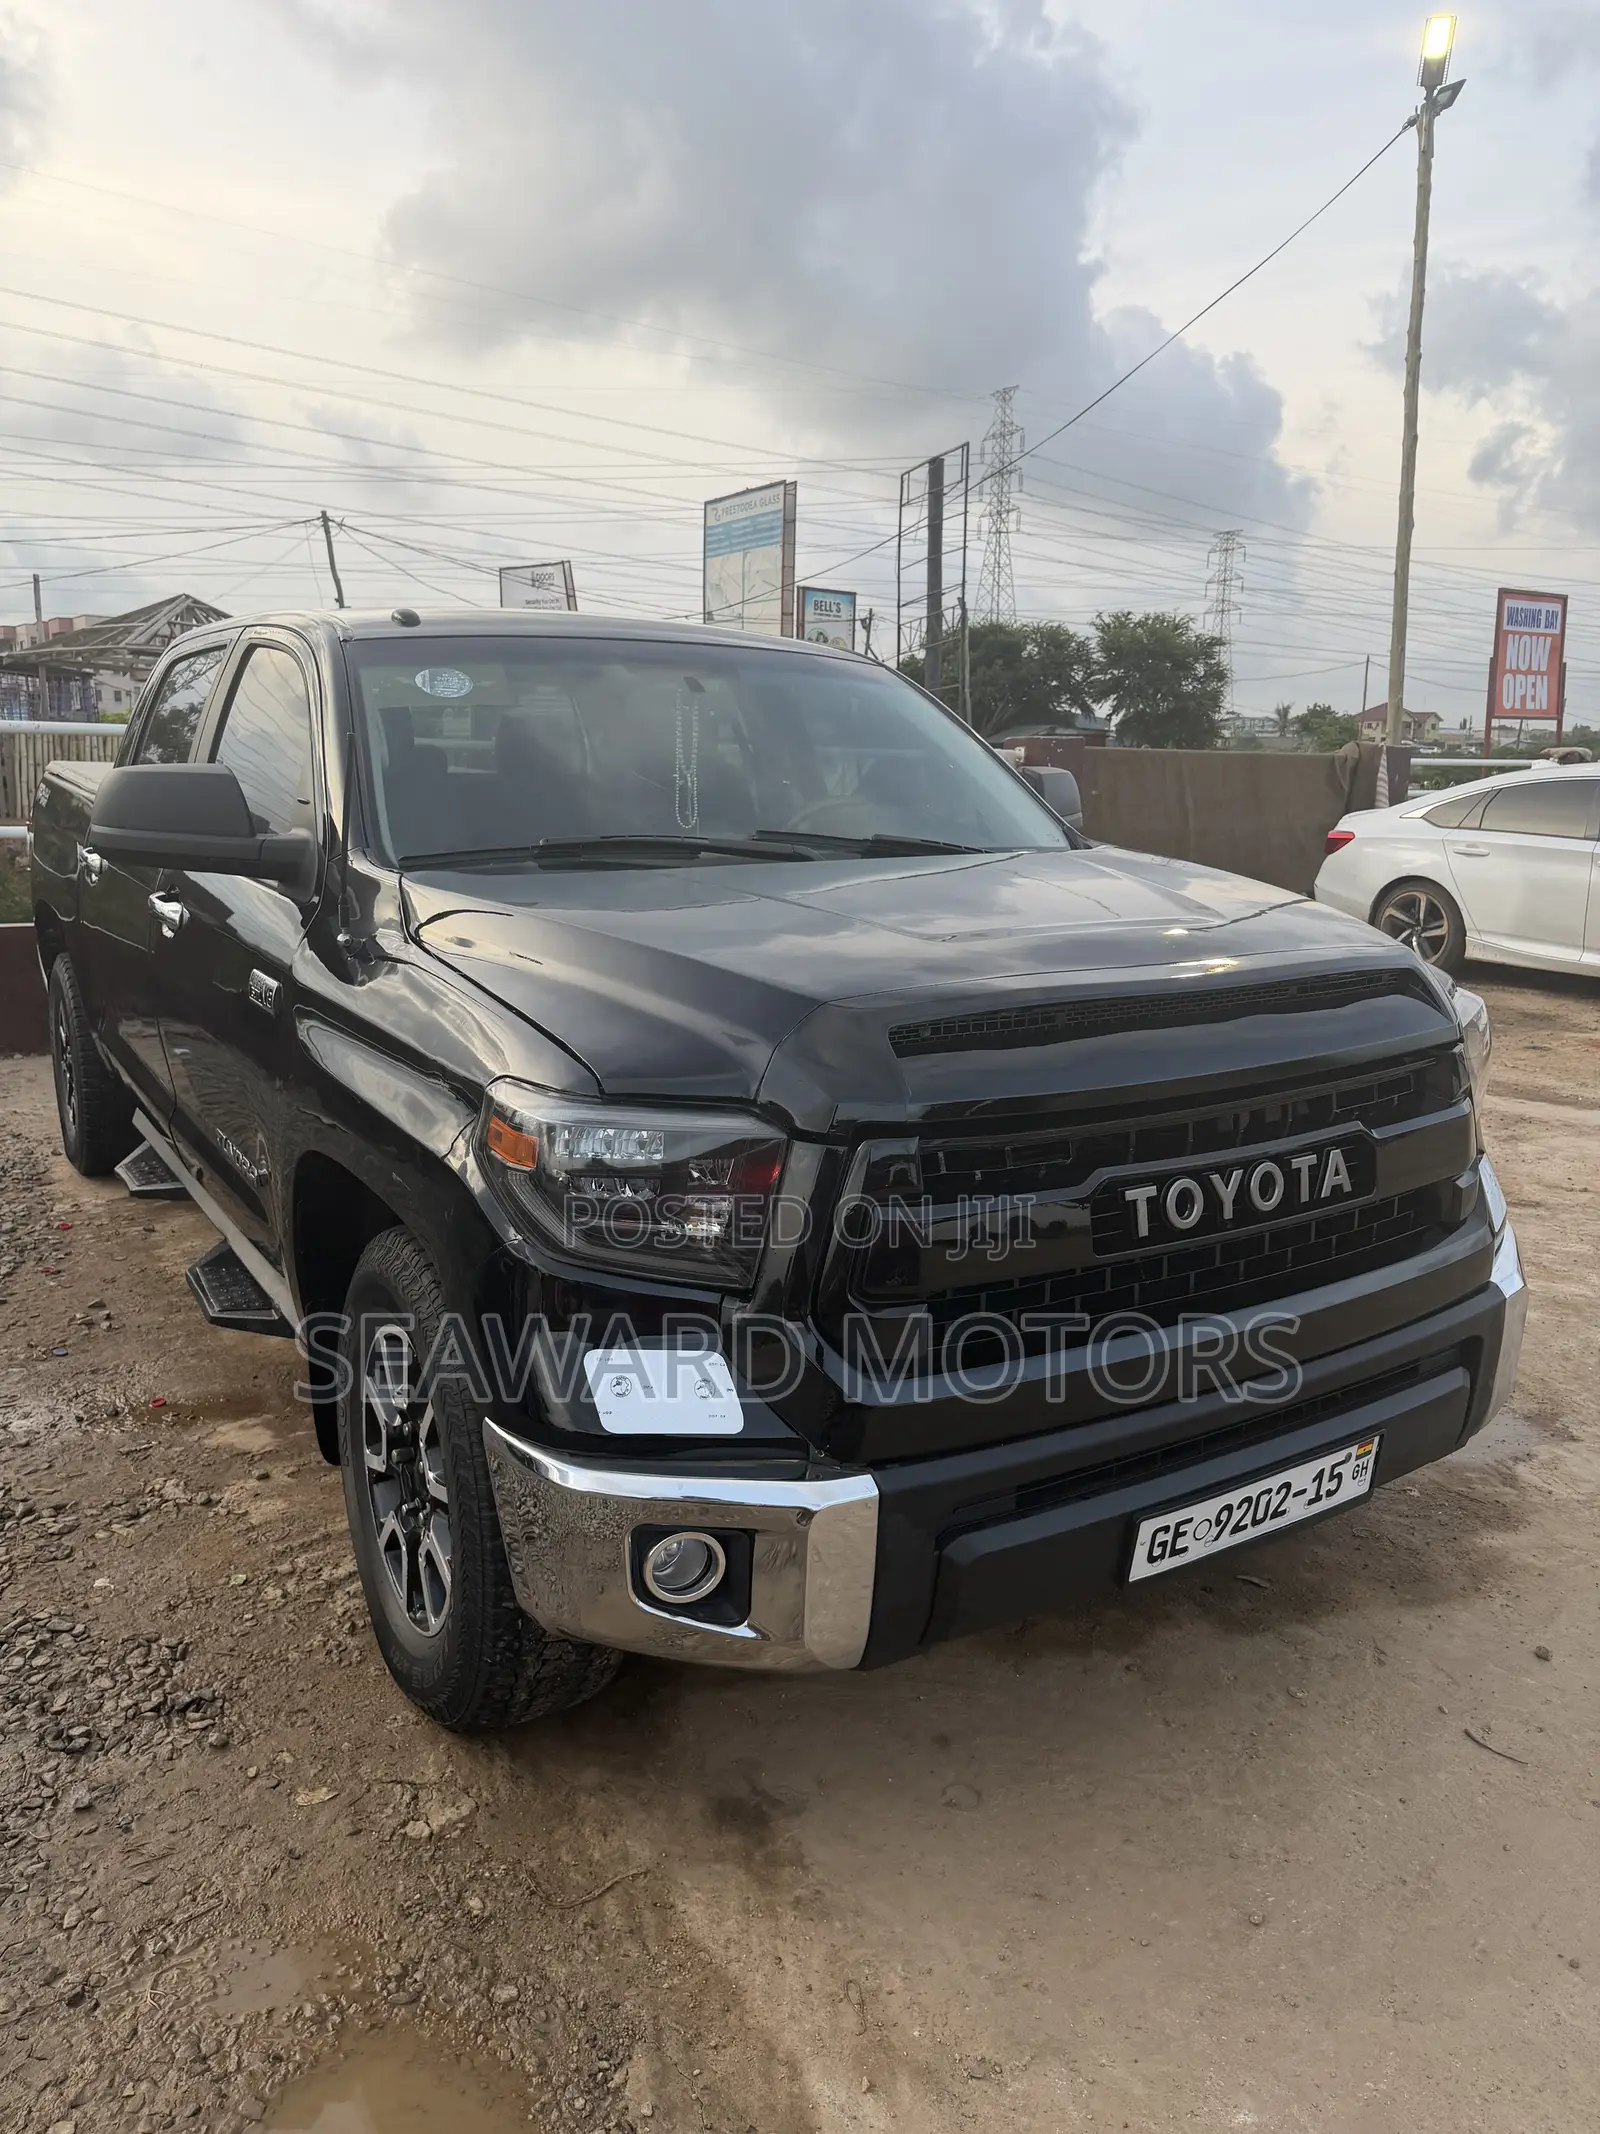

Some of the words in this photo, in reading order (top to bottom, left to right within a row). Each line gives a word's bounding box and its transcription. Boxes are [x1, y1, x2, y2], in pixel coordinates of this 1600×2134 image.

[759, 493, 780, 508] GLASS
[813, 599, 841, 613] BELL'S
[1506, 606, 1542, 629] WASHING
[1544, 609, 1560, 630] BAY
[1505, 633, 1552, 672] NOW
[1502, 672, 1548, 710] OPEN
[1122, 1148, 1352, 1238] TOYOTA
[1351, 1459, 1370, 1481] GH
[1146, 1516, 1194, 1565] GE
[1213, 1458, 1348, 1543] 9202-15
